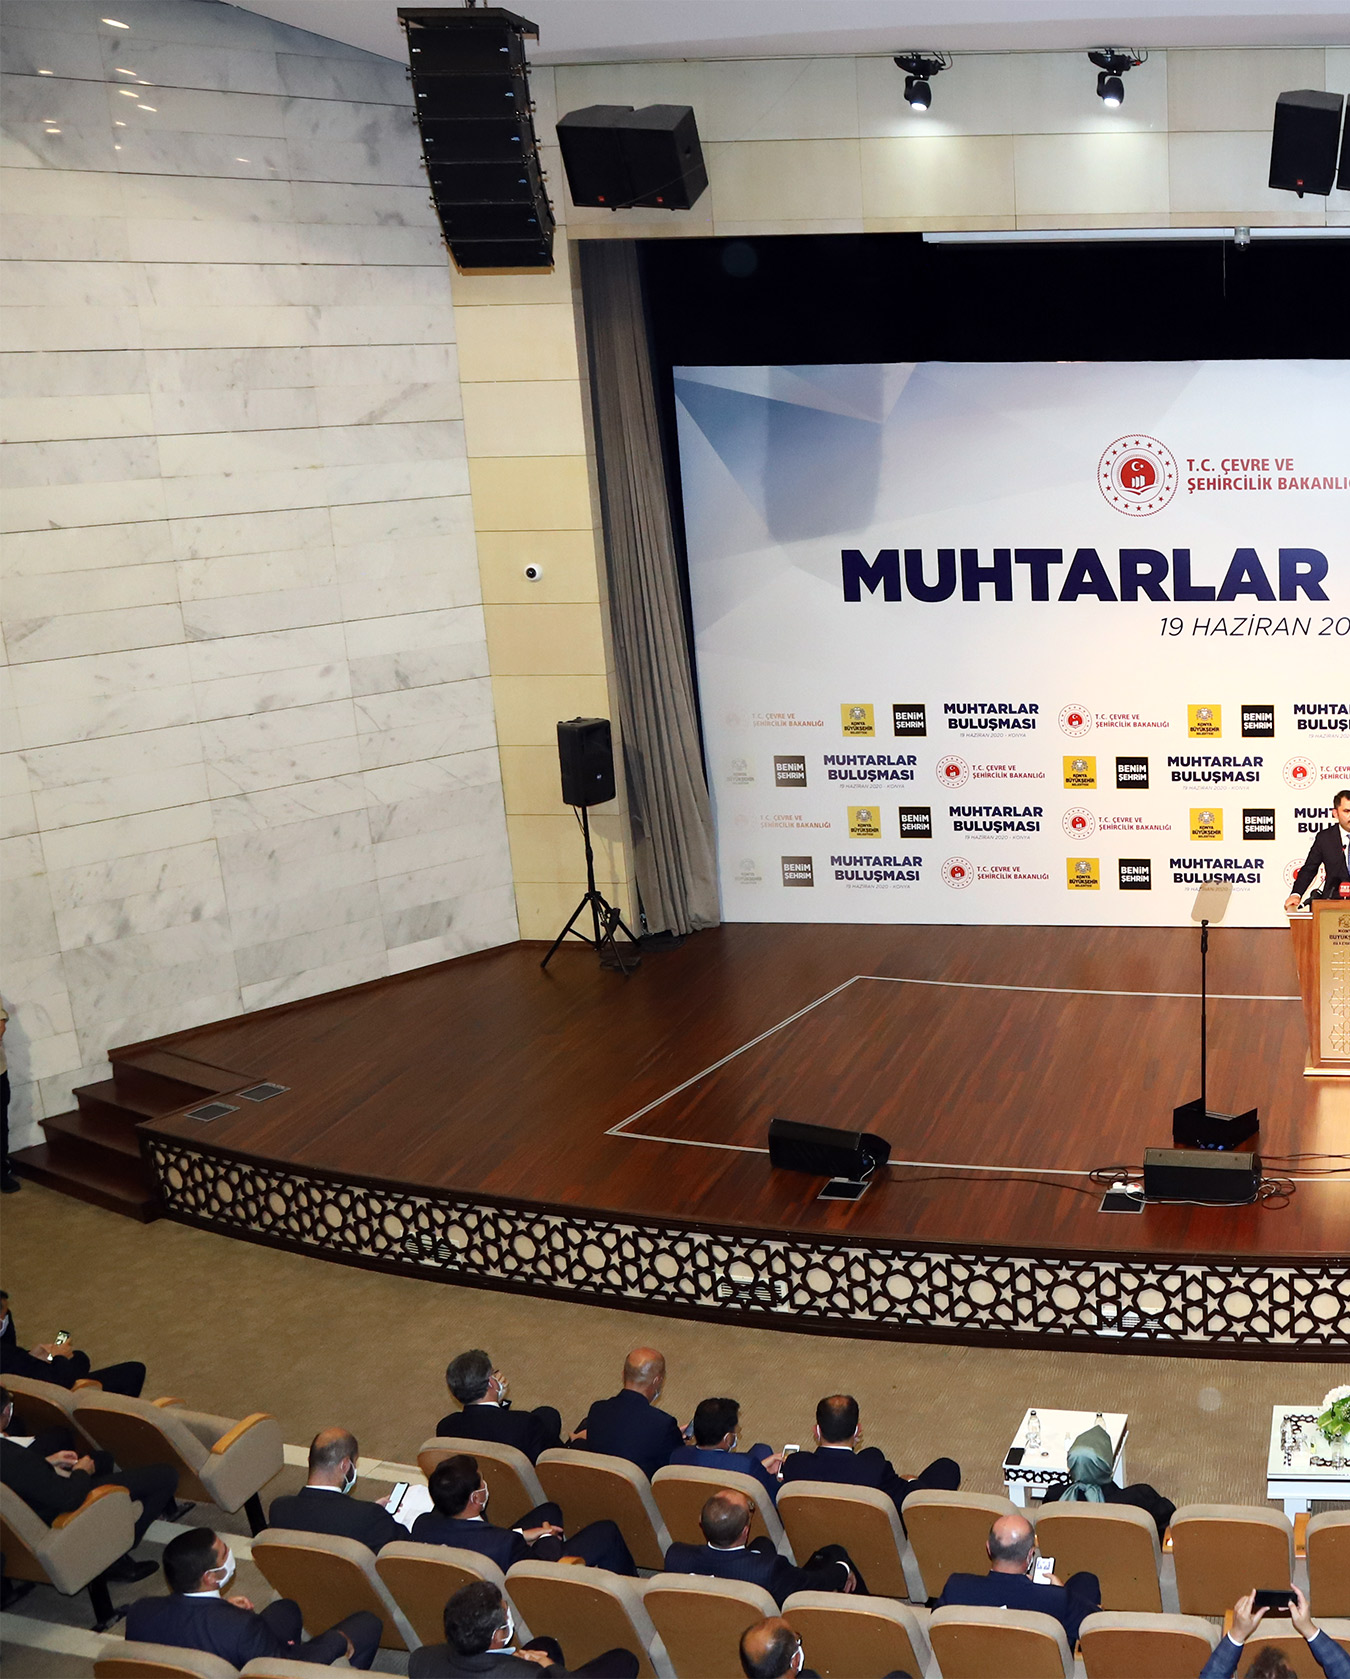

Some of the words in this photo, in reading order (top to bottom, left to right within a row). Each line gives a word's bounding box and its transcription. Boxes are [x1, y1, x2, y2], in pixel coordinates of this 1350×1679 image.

[1186, 459, 1215, 472] T.C.
[1221, 459, 1270, 475] ÇEVRE
[1275, 458, 1294, 471] VE
[1187, 474, 1272, 494] ŞEHİRCİLİK
[841, 548, 1330, 603] MUHTARLAR
[1161, 617, 1183, 636] 19
[1192, 614, 1312, 636] HAZİRAN
[944, 703, 1039, 714] MUHTARLAR
[948, 718, 1036, 730] BULUŞMASI
[824, 755, 917, 766] MUHTARLAR
[1167, 756, 1263, 767] MUHTARLAR
[828, 769, 914, 781] BULUŞMASI
[1171, 771, 1259, 783] BULUŞMASI
[949, 806, 1043, 817] MUHTARLAR
[953, 821, 1040, 832] BULUŞMASI
[831, 856, 922, 867] MUHTARLAR
[1170, 858, 1264, 869] MUHTARLAR
[835, 870, 920, 882] BULUŞMASI
[1173, 873, 1260, 885] BULUŞMASI
